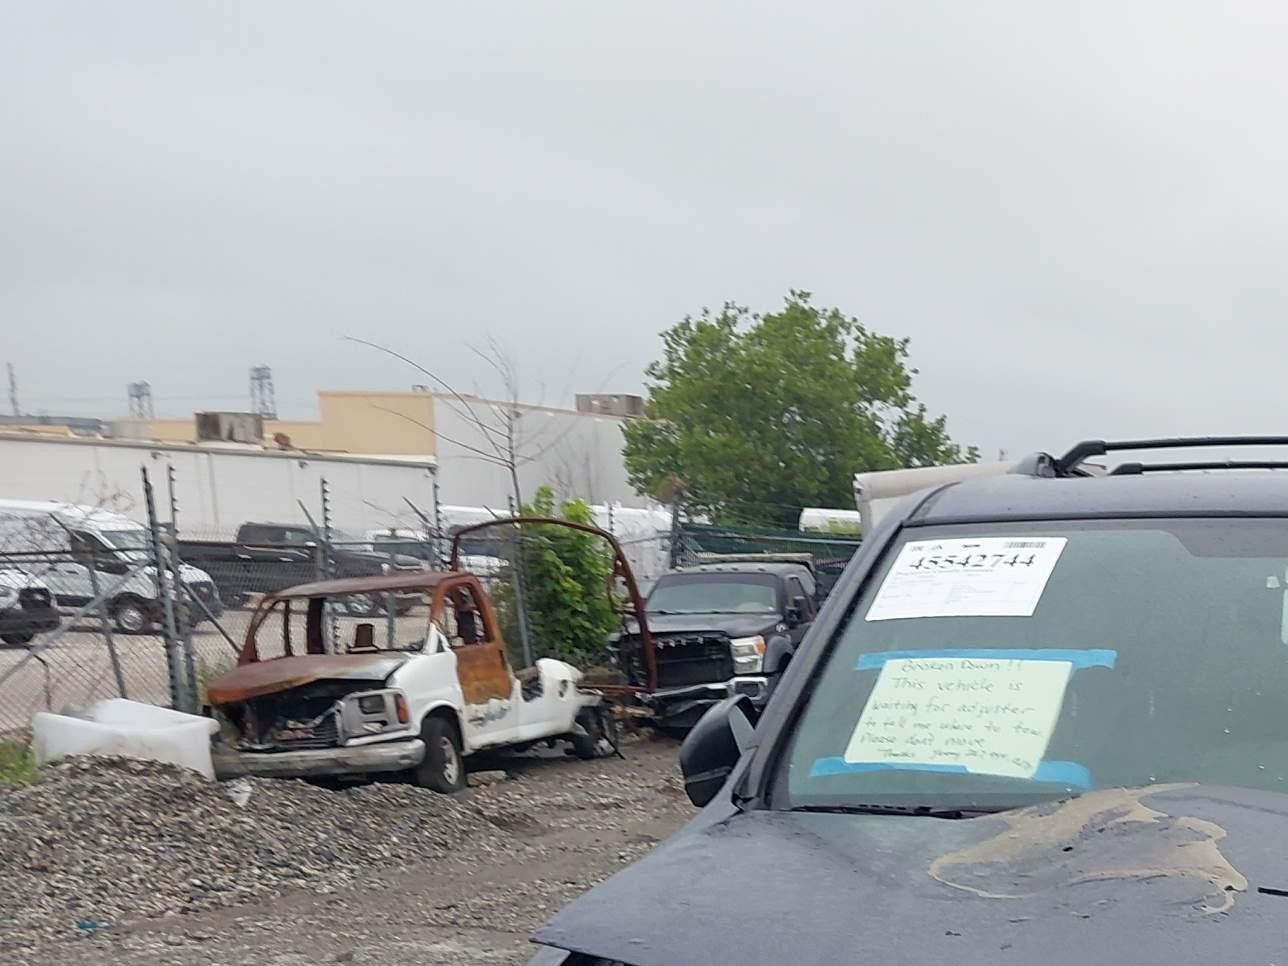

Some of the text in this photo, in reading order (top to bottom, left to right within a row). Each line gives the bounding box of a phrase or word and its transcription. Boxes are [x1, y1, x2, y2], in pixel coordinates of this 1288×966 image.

[909, 553, 1036, 570] 45542744
[892, 677, 926, 691] This
[1008, 679, 1024, 692] is
[926, 696, 950, 714] for
